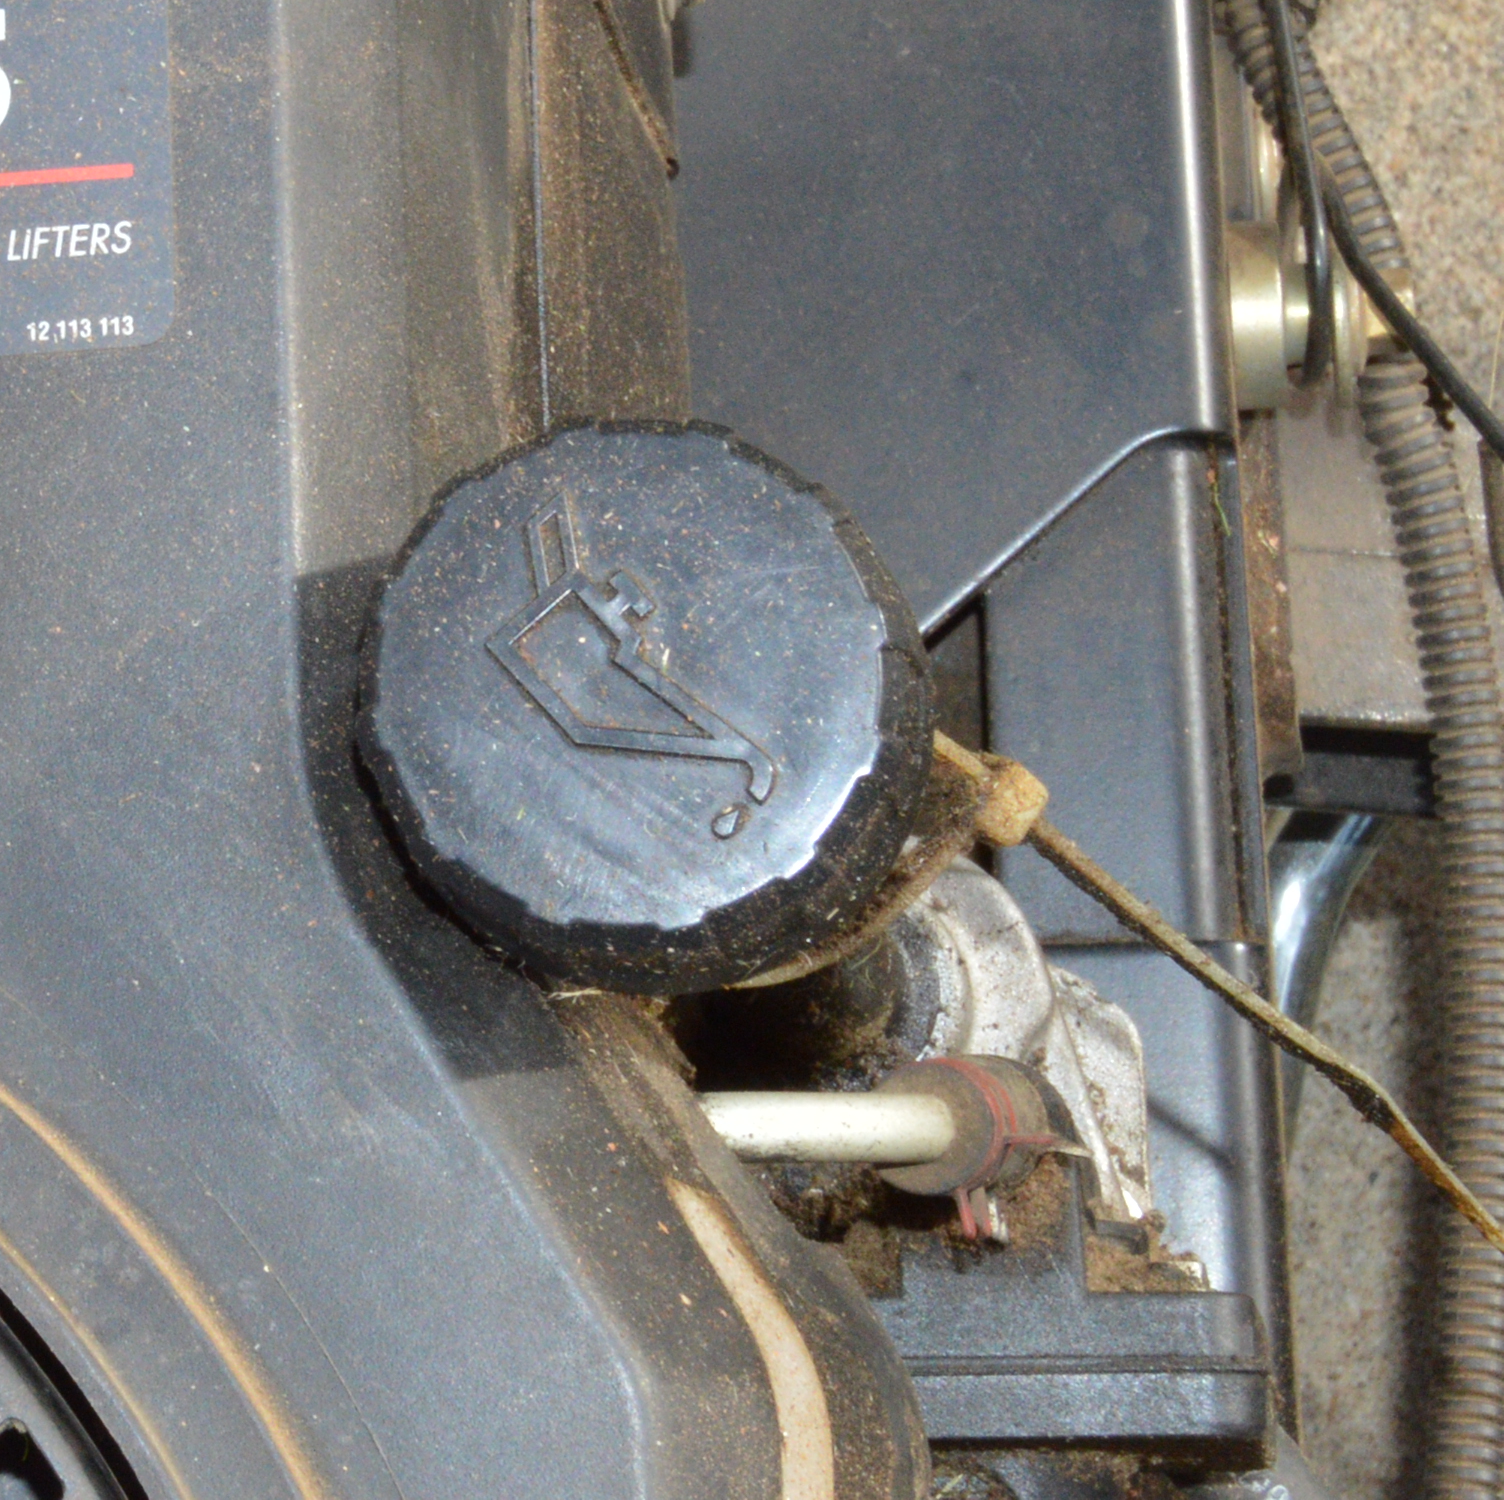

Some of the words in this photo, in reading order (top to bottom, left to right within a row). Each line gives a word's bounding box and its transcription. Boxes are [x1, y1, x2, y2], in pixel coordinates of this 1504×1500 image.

[6, 221, 134, 263] LIFTERS
[26, 320, 51, 342] 12
[55, 318, 92, 340] 113
[99, 315, 135, 337] 113
